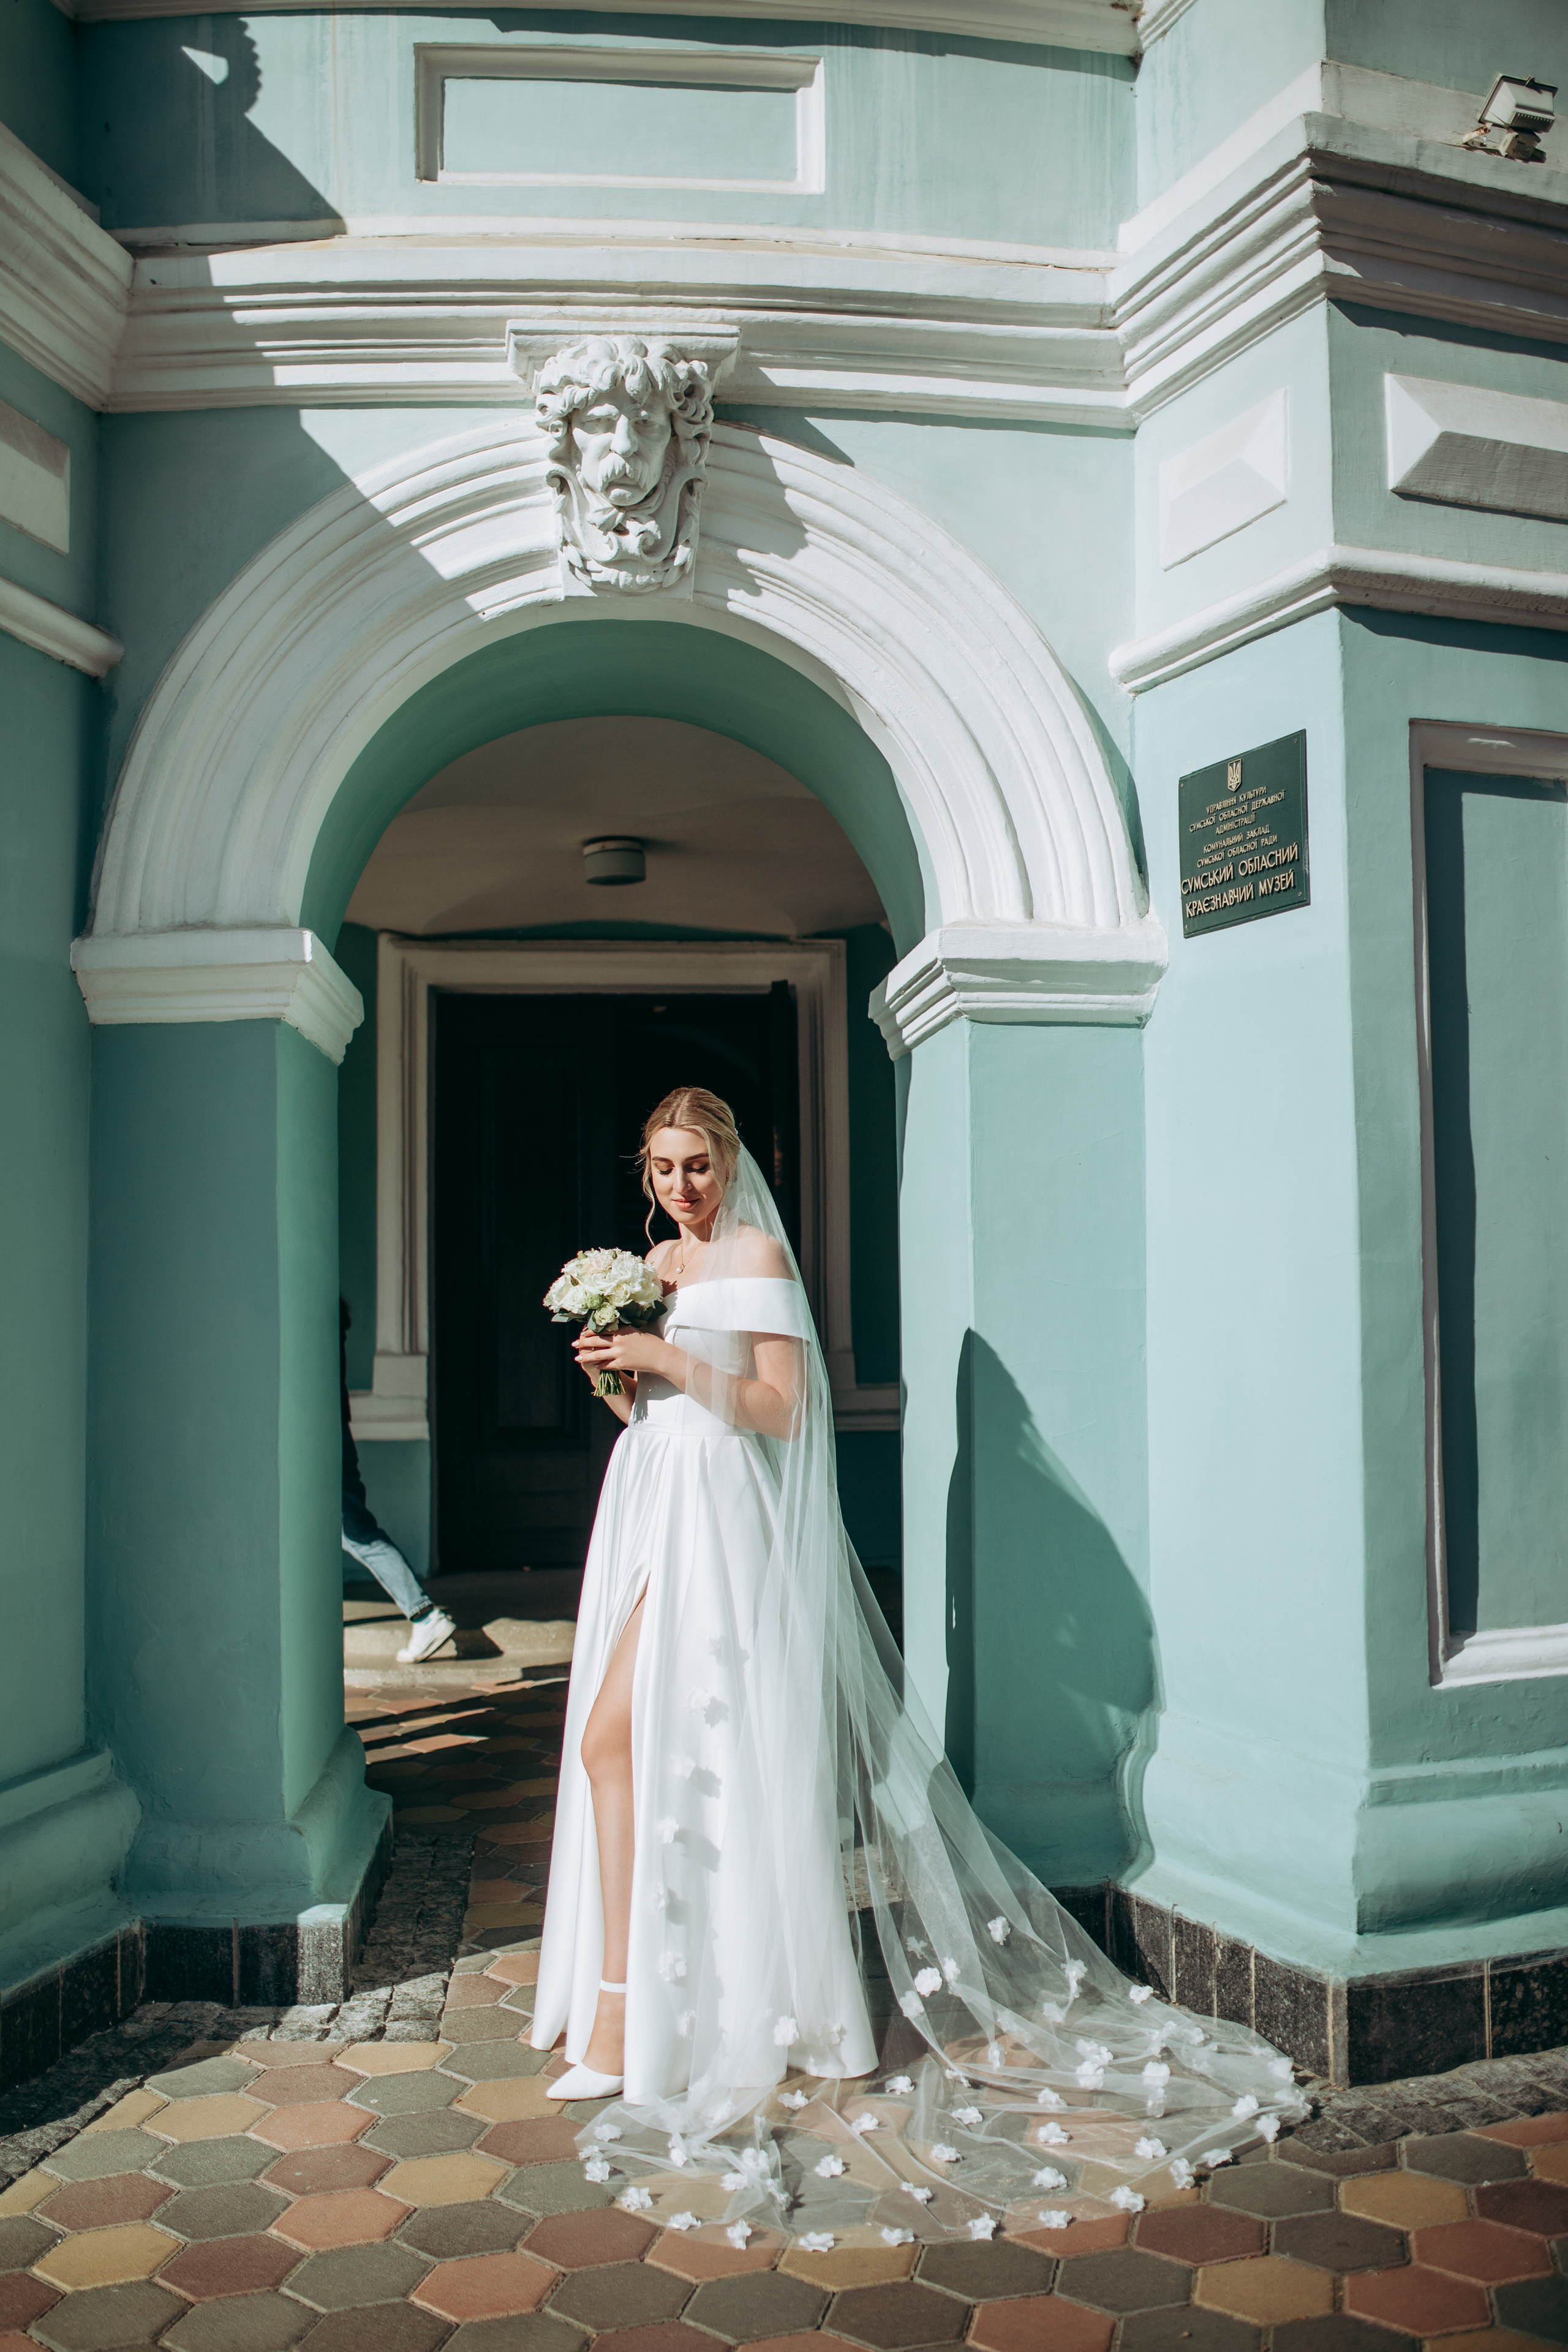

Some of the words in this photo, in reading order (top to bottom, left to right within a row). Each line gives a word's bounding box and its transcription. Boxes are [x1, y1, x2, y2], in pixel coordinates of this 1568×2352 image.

[1189, 816, 1216, 832] СУМСЬКОЇ
[1219, 802, 1248, 821] ОБЛАСНОЇ
[1252, 790, 1285, 810] ДЕРЖАВНОЇ
[1206, 796, 1236, 814] УПРАВЛІННЯ
[1240, 786, 1267, 802] КУЛЬТУРИ
[1204, 832, 1243, 853] КОМУНАЛЬНИЙ
[1246, 824, 1270, 839] ЗАКЛАД
[1216, 813, 1255, 835] АДМІНІСТРАЦІЇ
[1197, 851, 1224, 867] СУМСЬКОЇ
[1227, 840, 1257, 858] ОБЛАСНОЇ
[1261, 835, 1277, 847] РАДИ
[1182, 862, 1234, 894] СУМСЬКИЙ
[1238, 843, 1298, 876] ОБЛАСНИЙ
[1186, 882, 1254, 918] КРАЄЗНАВЧИЙ
[1259, 870, 1294, 897] МУЗЕЙ
